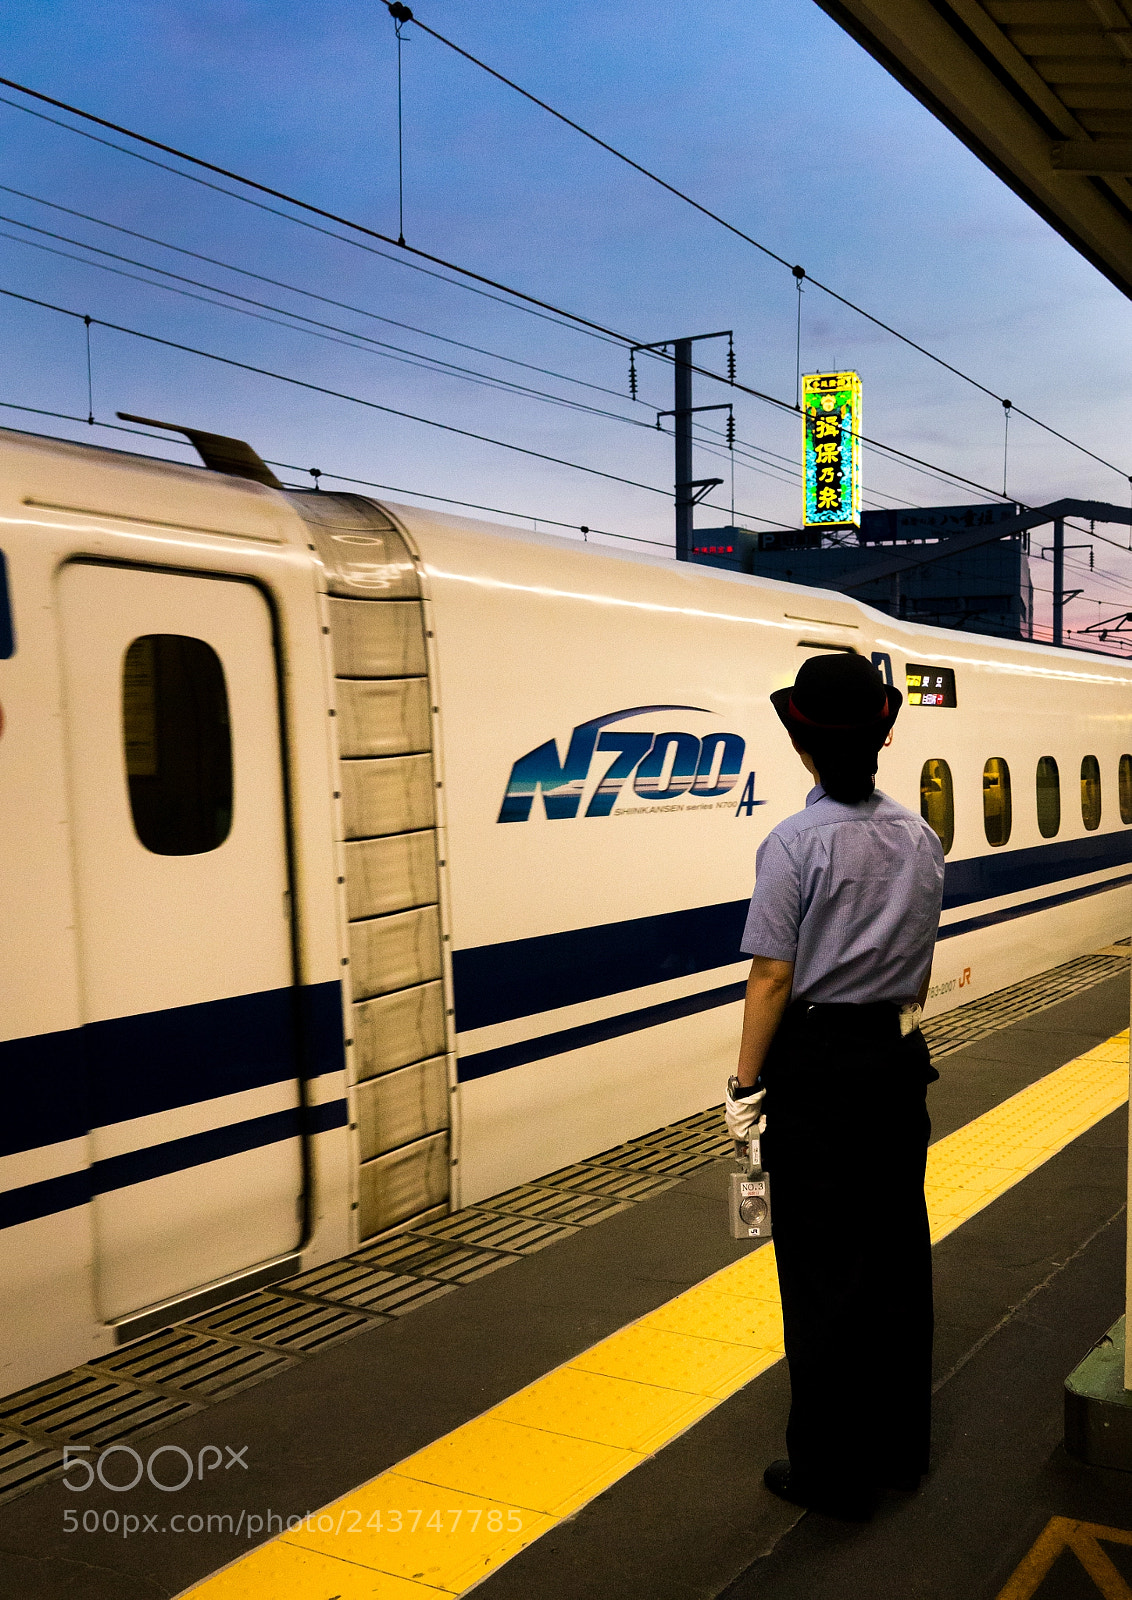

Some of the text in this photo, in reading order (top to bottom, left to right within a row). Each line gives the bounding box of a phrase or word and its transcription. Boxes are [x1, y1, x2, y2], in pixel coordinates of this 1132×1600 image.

[496, 706, 746, 823] N700
[614, 800, 737, 817] SHINKANSEN series N700
[958, 967, 971, 988] JR
